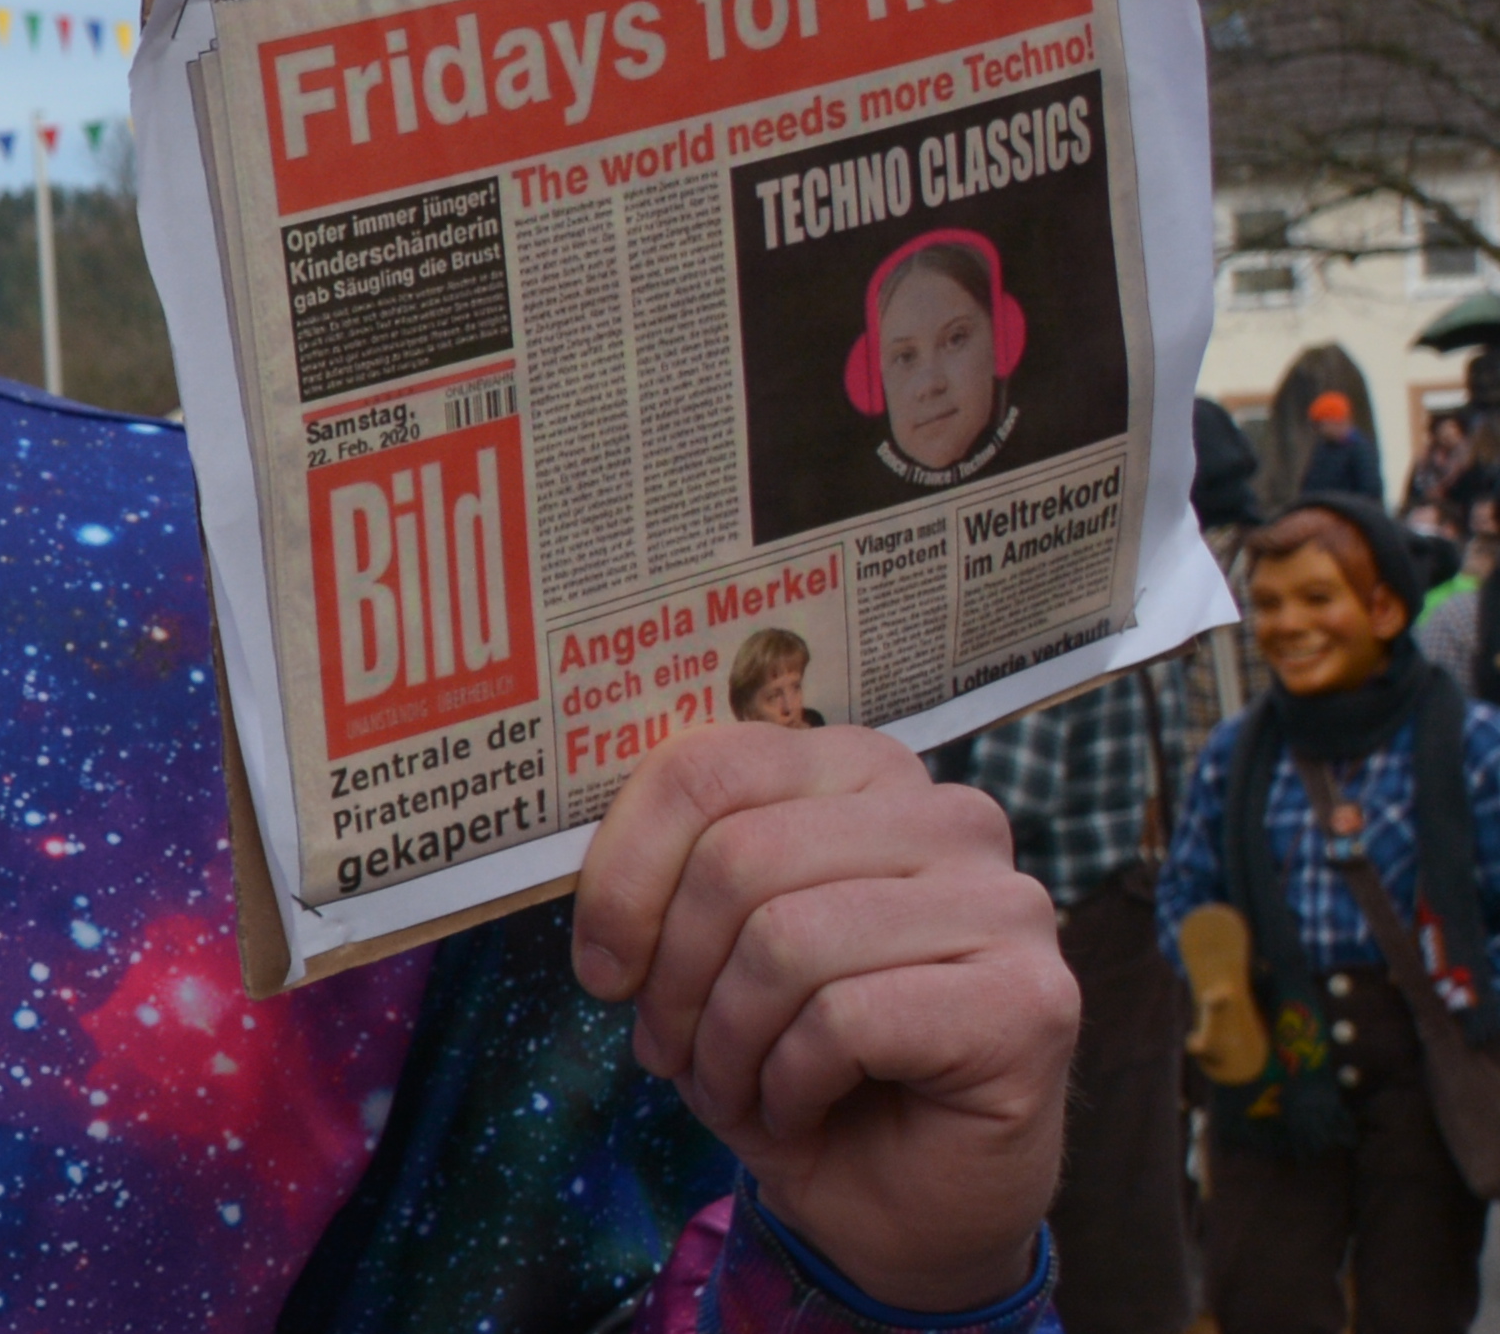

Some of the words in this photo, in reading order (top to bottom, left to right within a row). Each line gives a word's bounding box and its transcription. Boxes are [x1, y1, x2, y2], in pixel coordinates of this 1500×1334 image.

[275, 2, 665, 159] Fridays
[513, 165, 588, 207] The
[601, 124, 715, 186] world
[728, 96, 846, 154] needs
[860, 72, 954, 122] more
[964, 24, 1093, 90] Techno!
[756, 147, 911, 249] TECHNO
[919, 96, 1090, 207] CLASSICS
[287, 224, 346, 254] Opfer
[352, 207, 416, 236] immer
[423, 183, 495, 225] jünger!
[290, 211, 498, 287] Kinderschänderin
[294, 287, 329, 314] gab
[334, 268, 414, 300] Säugling
[419, 258, 447, 278] die
[451, 243, 500, 270] Brust
[307, 404, 415, 445] Samstag,
[308, 449, 331, 468] 22.
[338, 440, 373, 459] Feb.
[380, 424, 420, 447] 2020
[855, 528, 913, 555] Viagra
[964, 465, 1120, 550] Weltrekord
[965, 554, 992, 580] im
[1002, 501, 1117, 569] Amoklauf!
[331, 448, 509, 703] Bild
[856, 534, 947, 581] impotent
[560, 605, 695, 675] Angela
[706, 555, 838, 627] Merkel
[562, 666, 643, 719] doch
[654, 649, 719, 689] eine
[952, 649, 1026, 697] Lotterie
[331, 736, 470, 803] Zentrale
[487, 717, 541, 750] der
[331, 753, 547, 844] Piratenpartei
[337, 792, 546, 892] gekapert!
